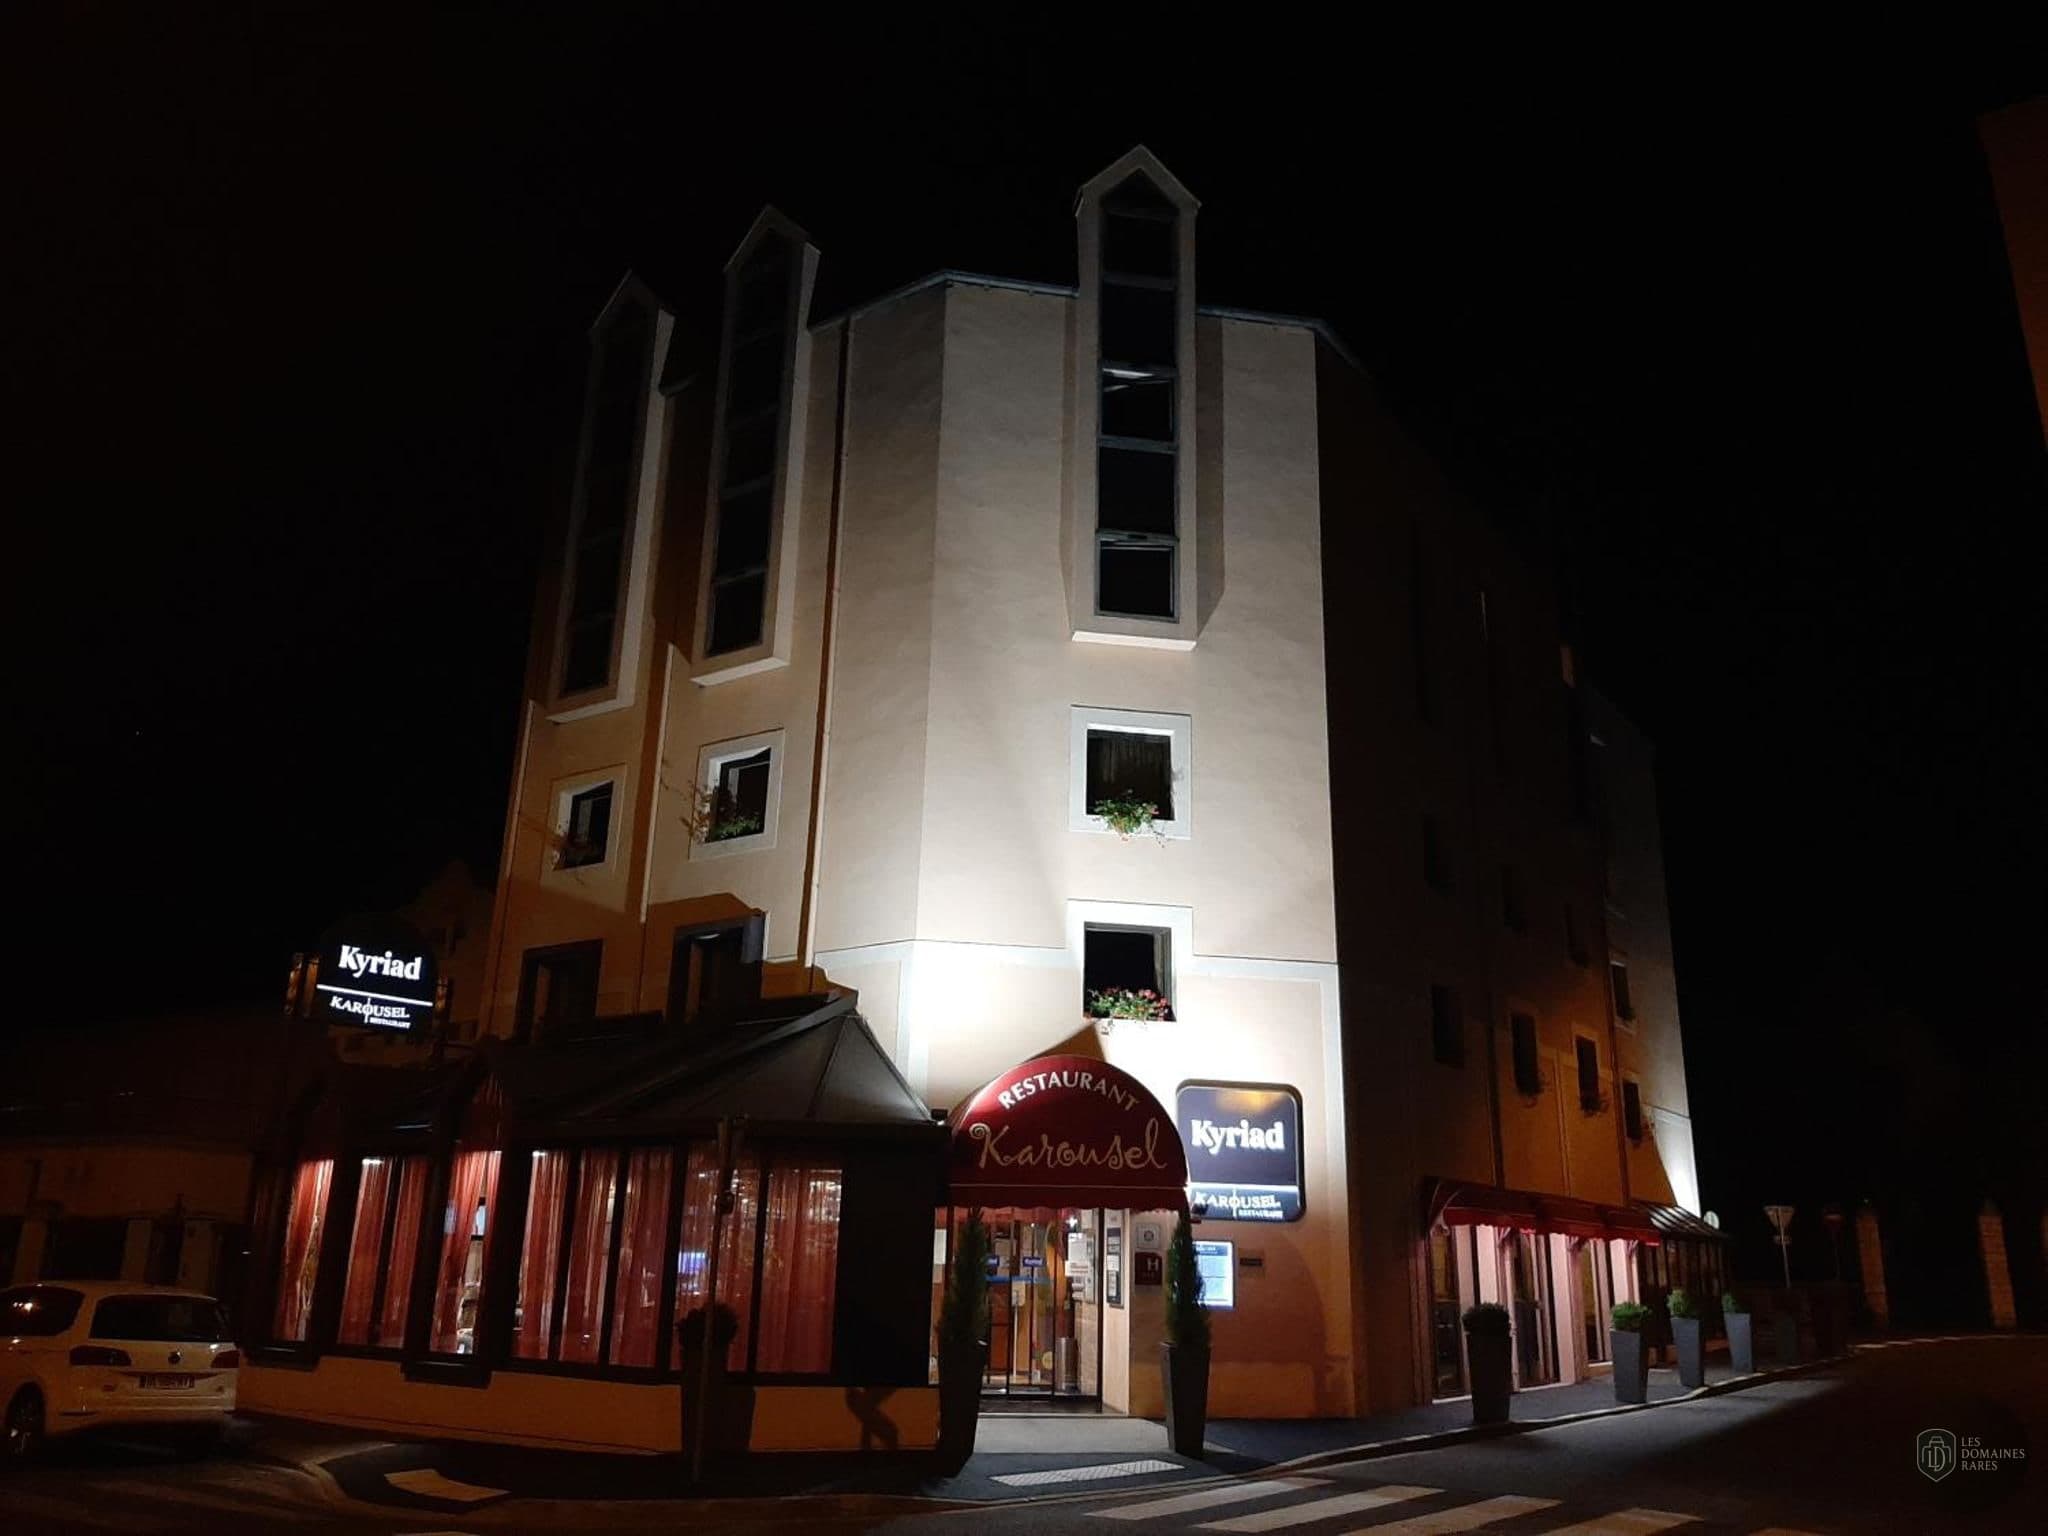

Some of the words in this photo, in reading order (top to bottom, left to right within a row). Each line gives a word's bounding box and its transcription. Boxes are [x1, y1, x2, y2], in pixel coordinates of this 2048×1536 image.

[338, 944, 422, 980] Kyriad
[329, 996, 410, 1019] KAROUSEL
[998, 1071, 1140, 1110] RESTAURANT
[969, 1118, 1167, 1169] Karousel
[1191, 1119, 1285, 1156] Kyriad
[1194, 1191, 1282, 1209] KAROUSEL
